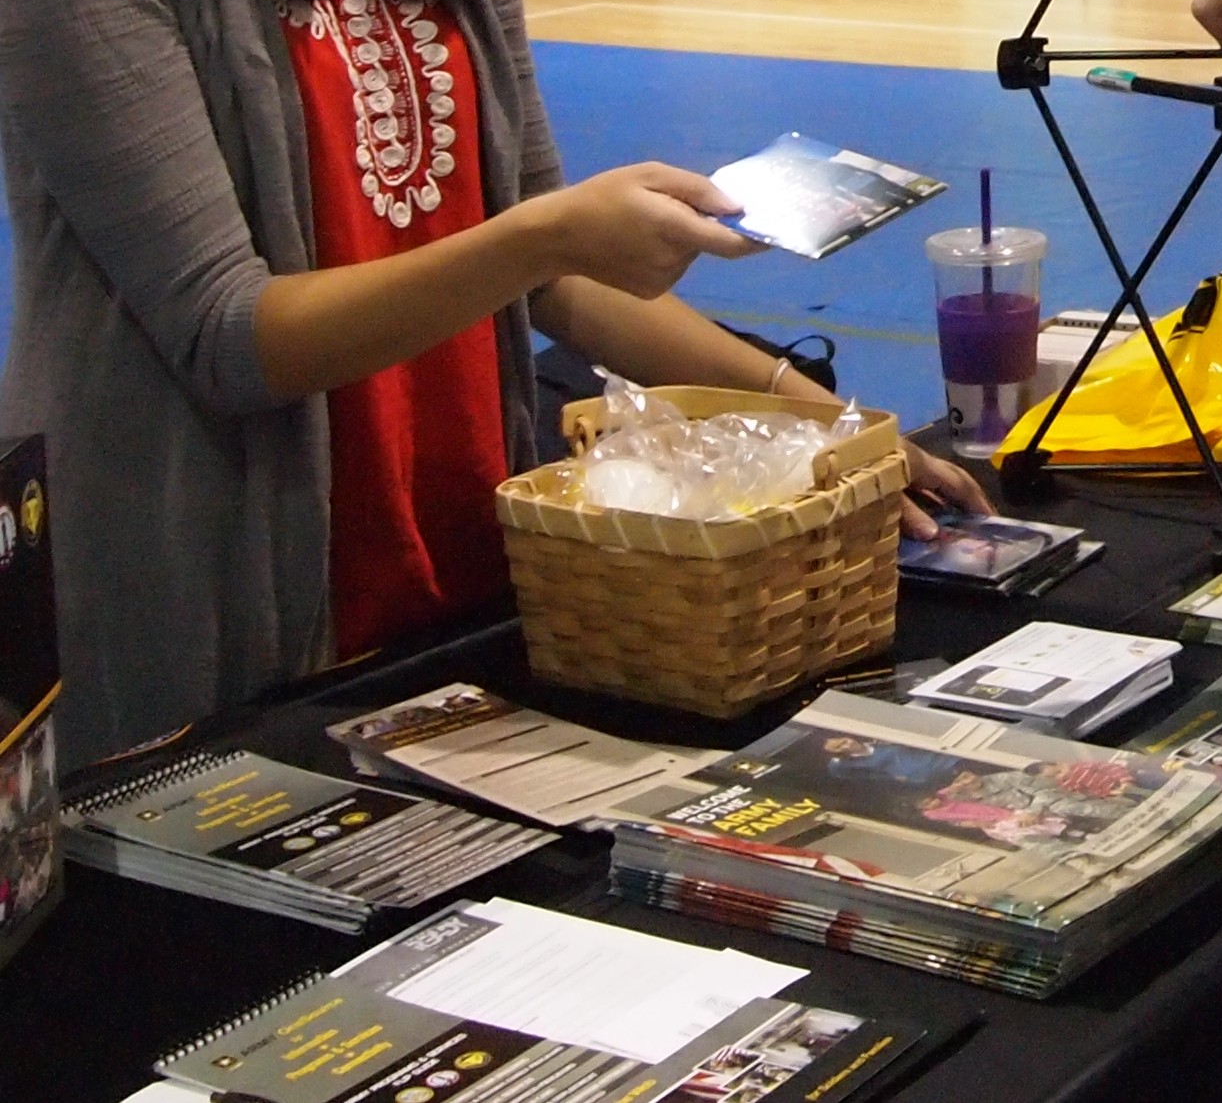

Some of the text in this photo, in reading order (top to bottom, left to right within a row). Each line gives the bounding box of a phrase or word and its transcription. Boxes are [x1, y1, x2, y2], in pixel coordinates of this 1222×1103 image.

[666, 784, 752, 820] WELCOME
[685, 798, 753, 826] TO THE
[712, 798, 782, 833] ARMY
[734, 798, 822, 837] FAMILY
